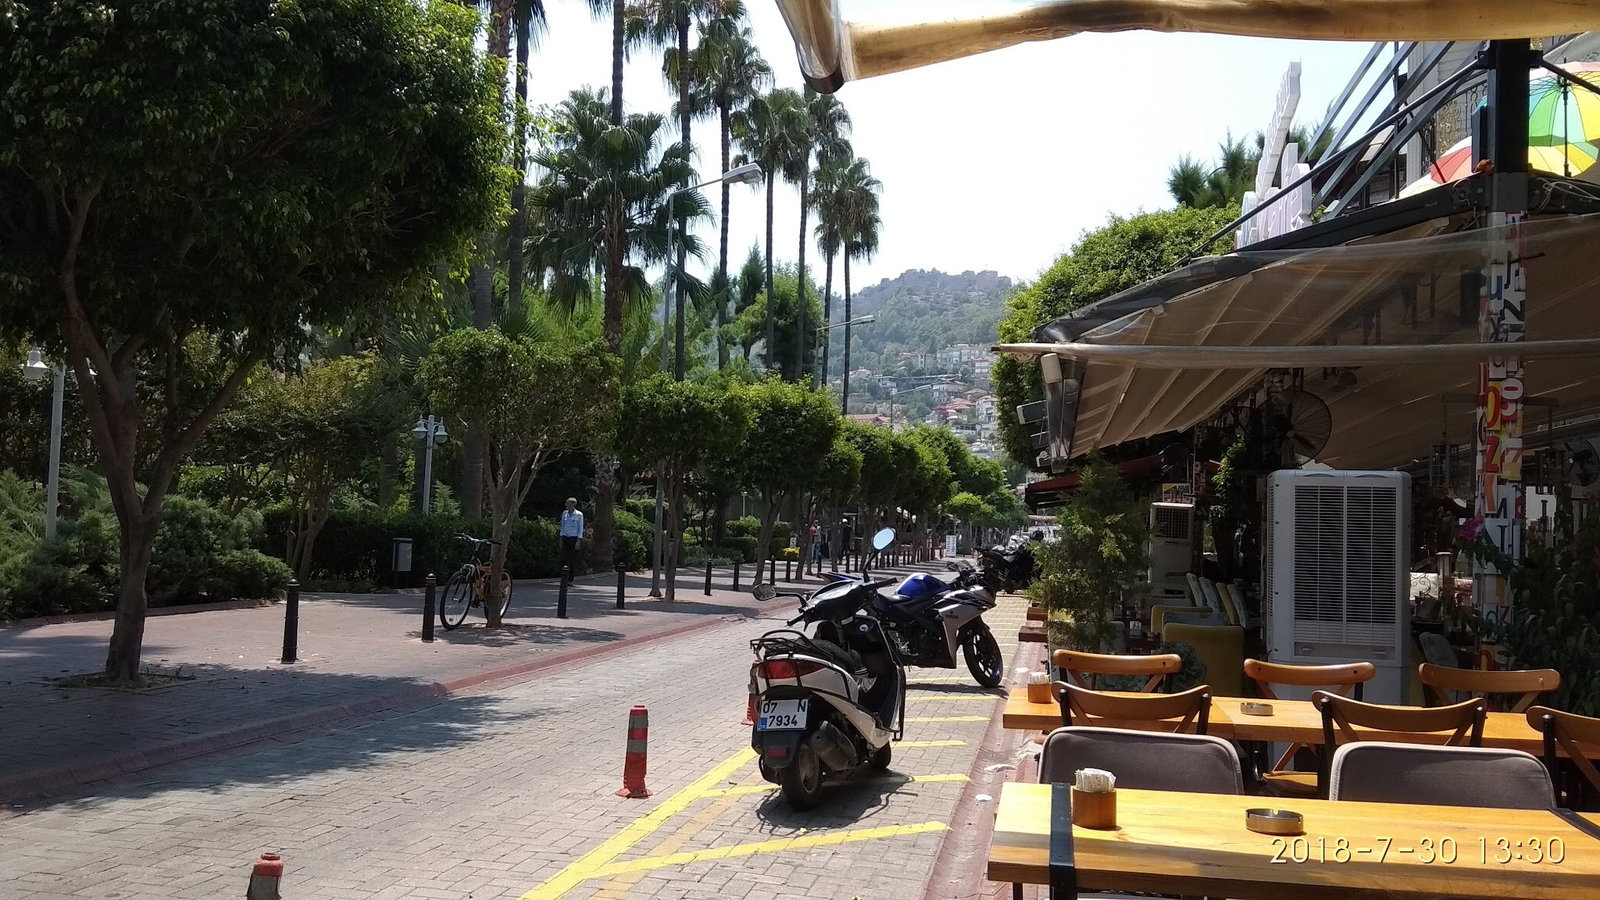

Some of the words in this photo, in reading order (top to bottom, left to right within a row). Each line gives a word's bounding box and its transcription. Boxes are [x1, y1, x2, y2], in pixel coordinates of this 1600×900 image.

[762, 701, 779, 714] 07
[797, 700, 807, 713] N
[768, 714, 798, 727] 7934
